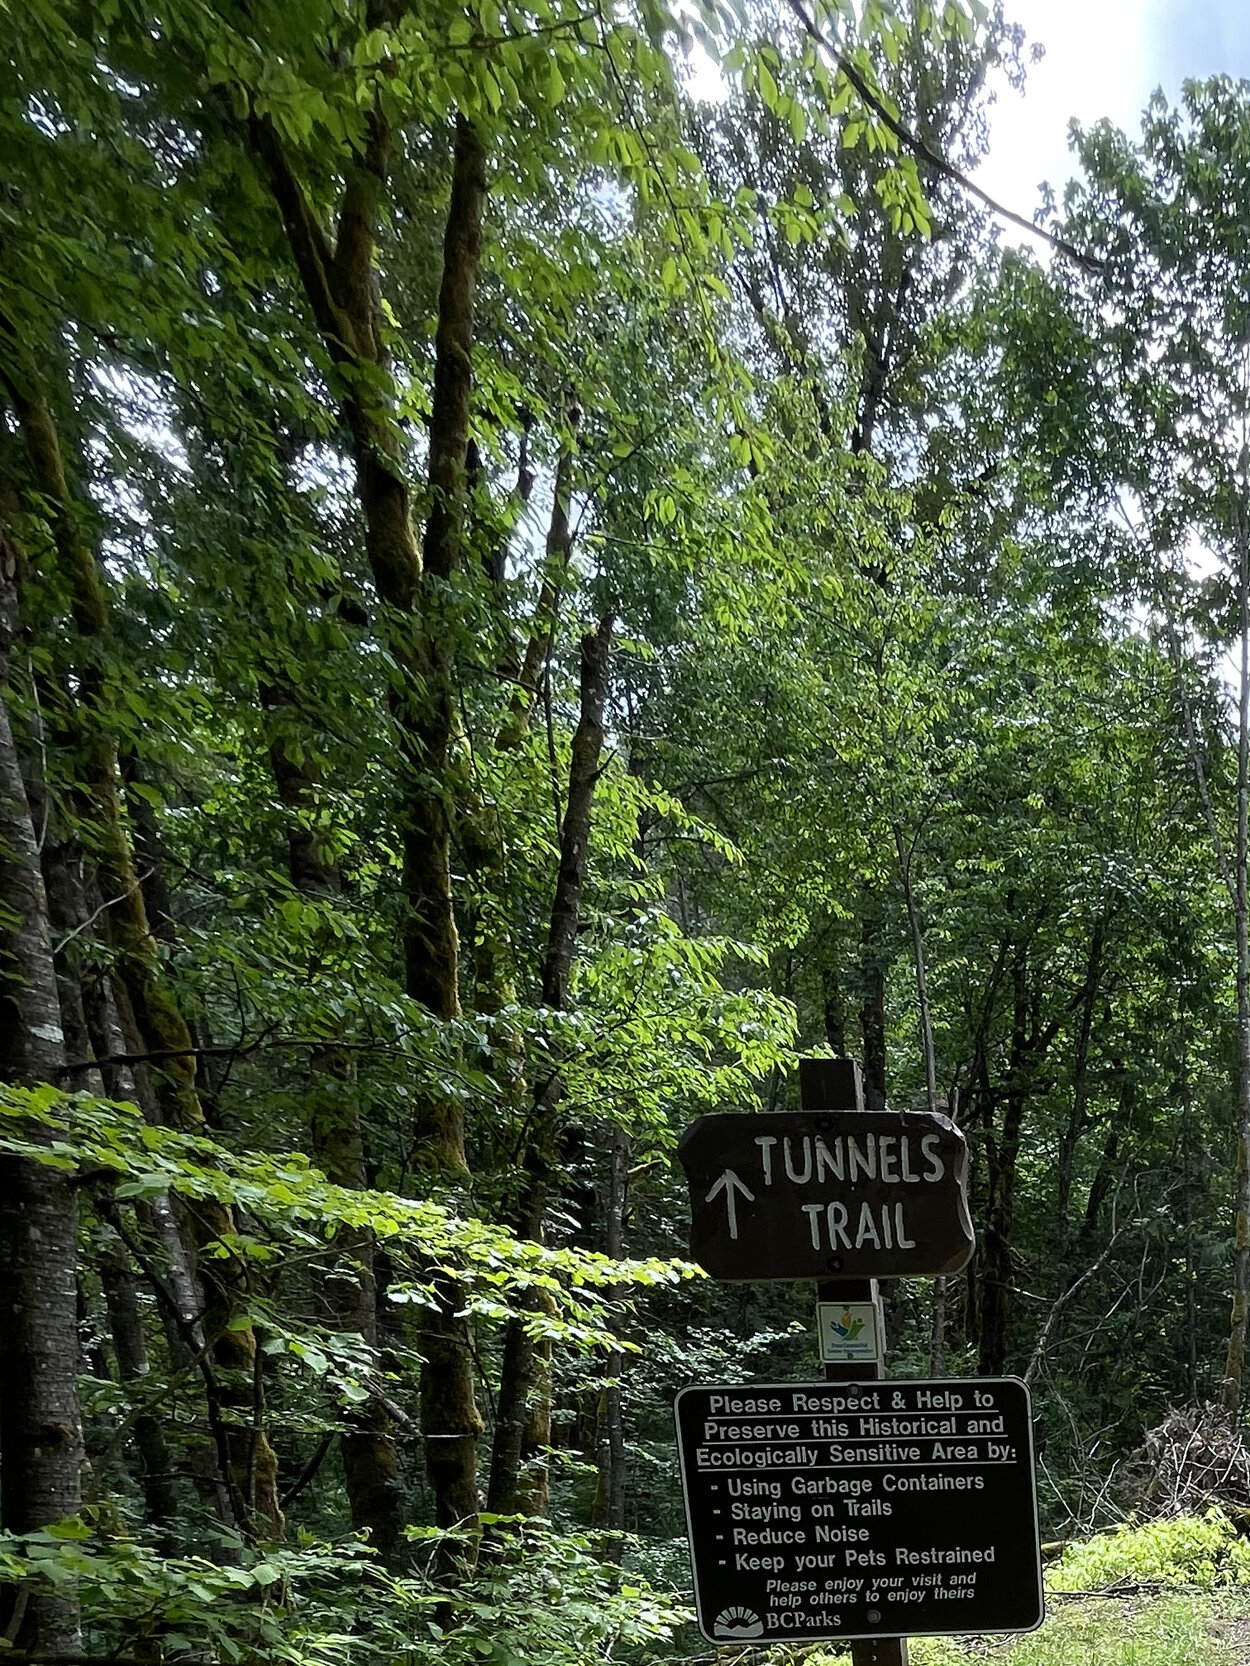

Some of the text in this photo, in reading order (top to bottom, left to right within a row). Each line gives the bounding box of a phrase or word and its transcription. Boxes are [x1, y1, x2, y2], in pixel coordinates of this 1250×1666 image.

[755, 1133, 945, 1185] TUNNELS
[801, 1202, 916, 1250] TRAIL
[709, 1389, 994, 1413] Please Respect & Help to
[704, 1416, 1004, 1439] Preserve this Historical and
[696, 1442, 1017, 1467] Ecologically Sensitive Area by:
[728, 1479, 781, 1498] Using
[791, 1476, 873, 1496] Garbage
[883, 1474, 984, 1492] Containers
[731, 1502, 801, 1523] Staying
[811, 1503, 834, 1518] on
[844, 1499, 892, 1517] Trails
[734, 1527, 806, 1545] Reduce
[816, 1525, 869, 1543] Noise
[735, 1553, 784, 1573] Keep
[795, 1554, 836, 1572] your
[845, 1549, 886, 1567] Pets
[896, 1546, 995, 1565] Restrained
[766, 1572, 976, 1592] Please enjoy your visit and
[769, 1587, 975, 1608] help others to enjoy theirs
